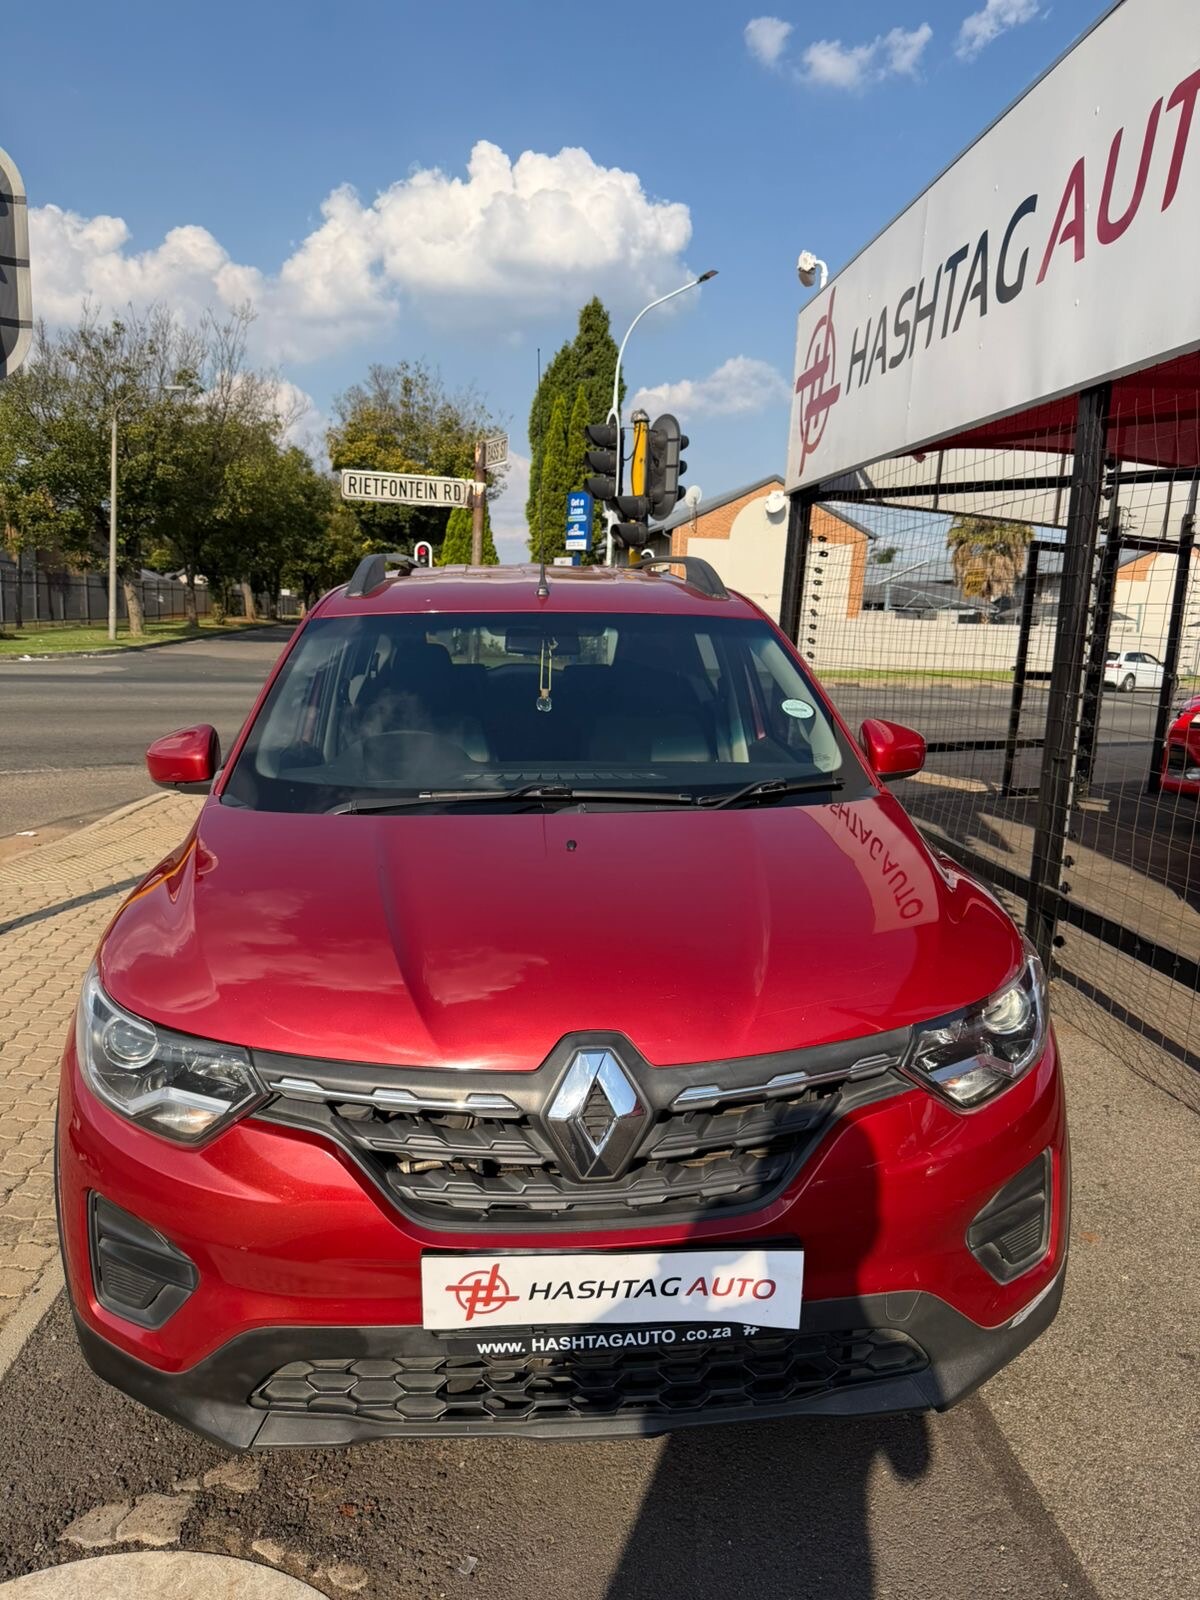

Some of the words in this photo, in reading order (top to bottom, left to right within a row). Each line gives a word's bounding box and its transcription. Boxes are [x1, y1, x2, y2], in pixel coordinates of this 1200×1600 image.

[846, 194, 1038, 395] HASHTAG
[348, 476, 437, 500] RIETFONTEIN
[443, 483, 461, 501] RD
[528, 1277, 682, 1300] HASHTAG
[685, 1276, 776, 1300] AUTO
[477, 1342, 525, 1354] www.
[532, 1329, 676, 1352] HASHTAGAUTO
[681, 1327, 732, 1341] .co.za
